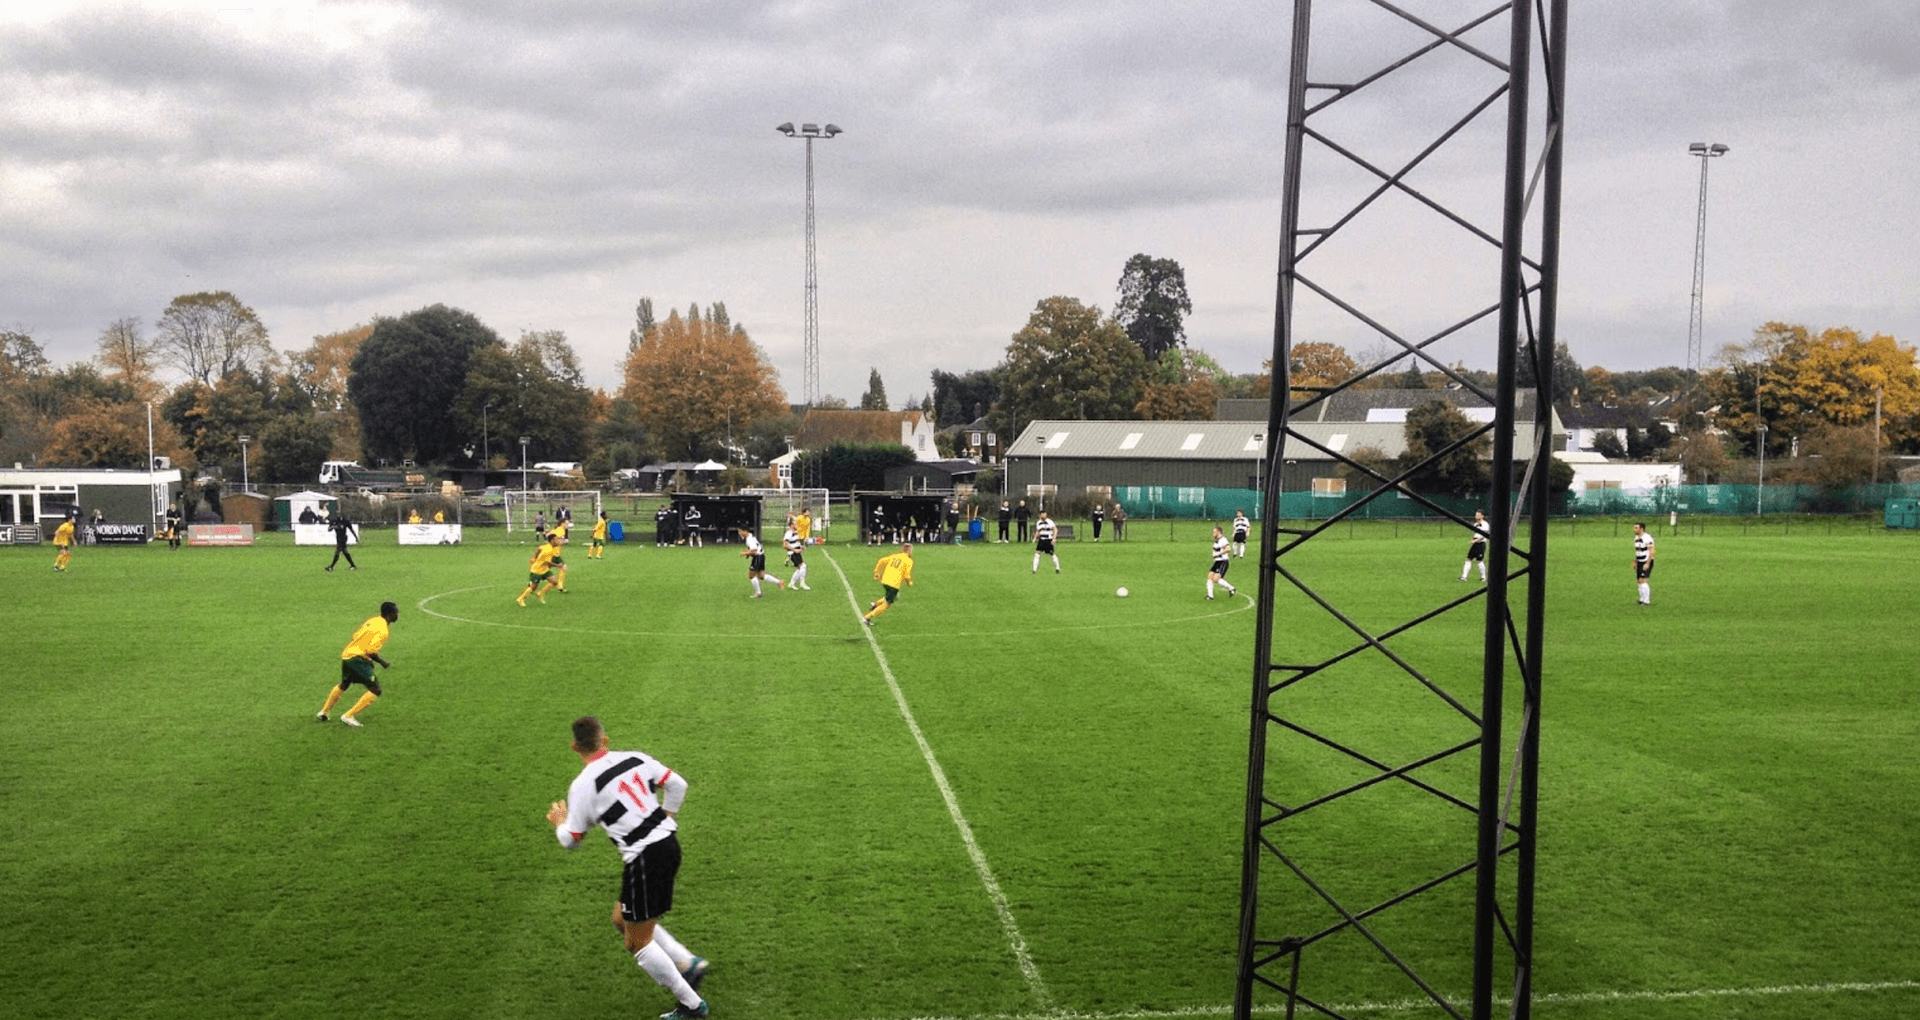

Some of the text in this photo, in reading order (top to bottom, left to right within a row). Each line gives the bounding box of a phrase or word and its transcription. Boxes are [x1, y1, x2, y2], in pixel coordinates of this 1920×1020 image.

[96, 524, 145, 535] NORDIN DANCE
[890, 558, 902, 569] 10
[618, 772, 649, 813] 11
